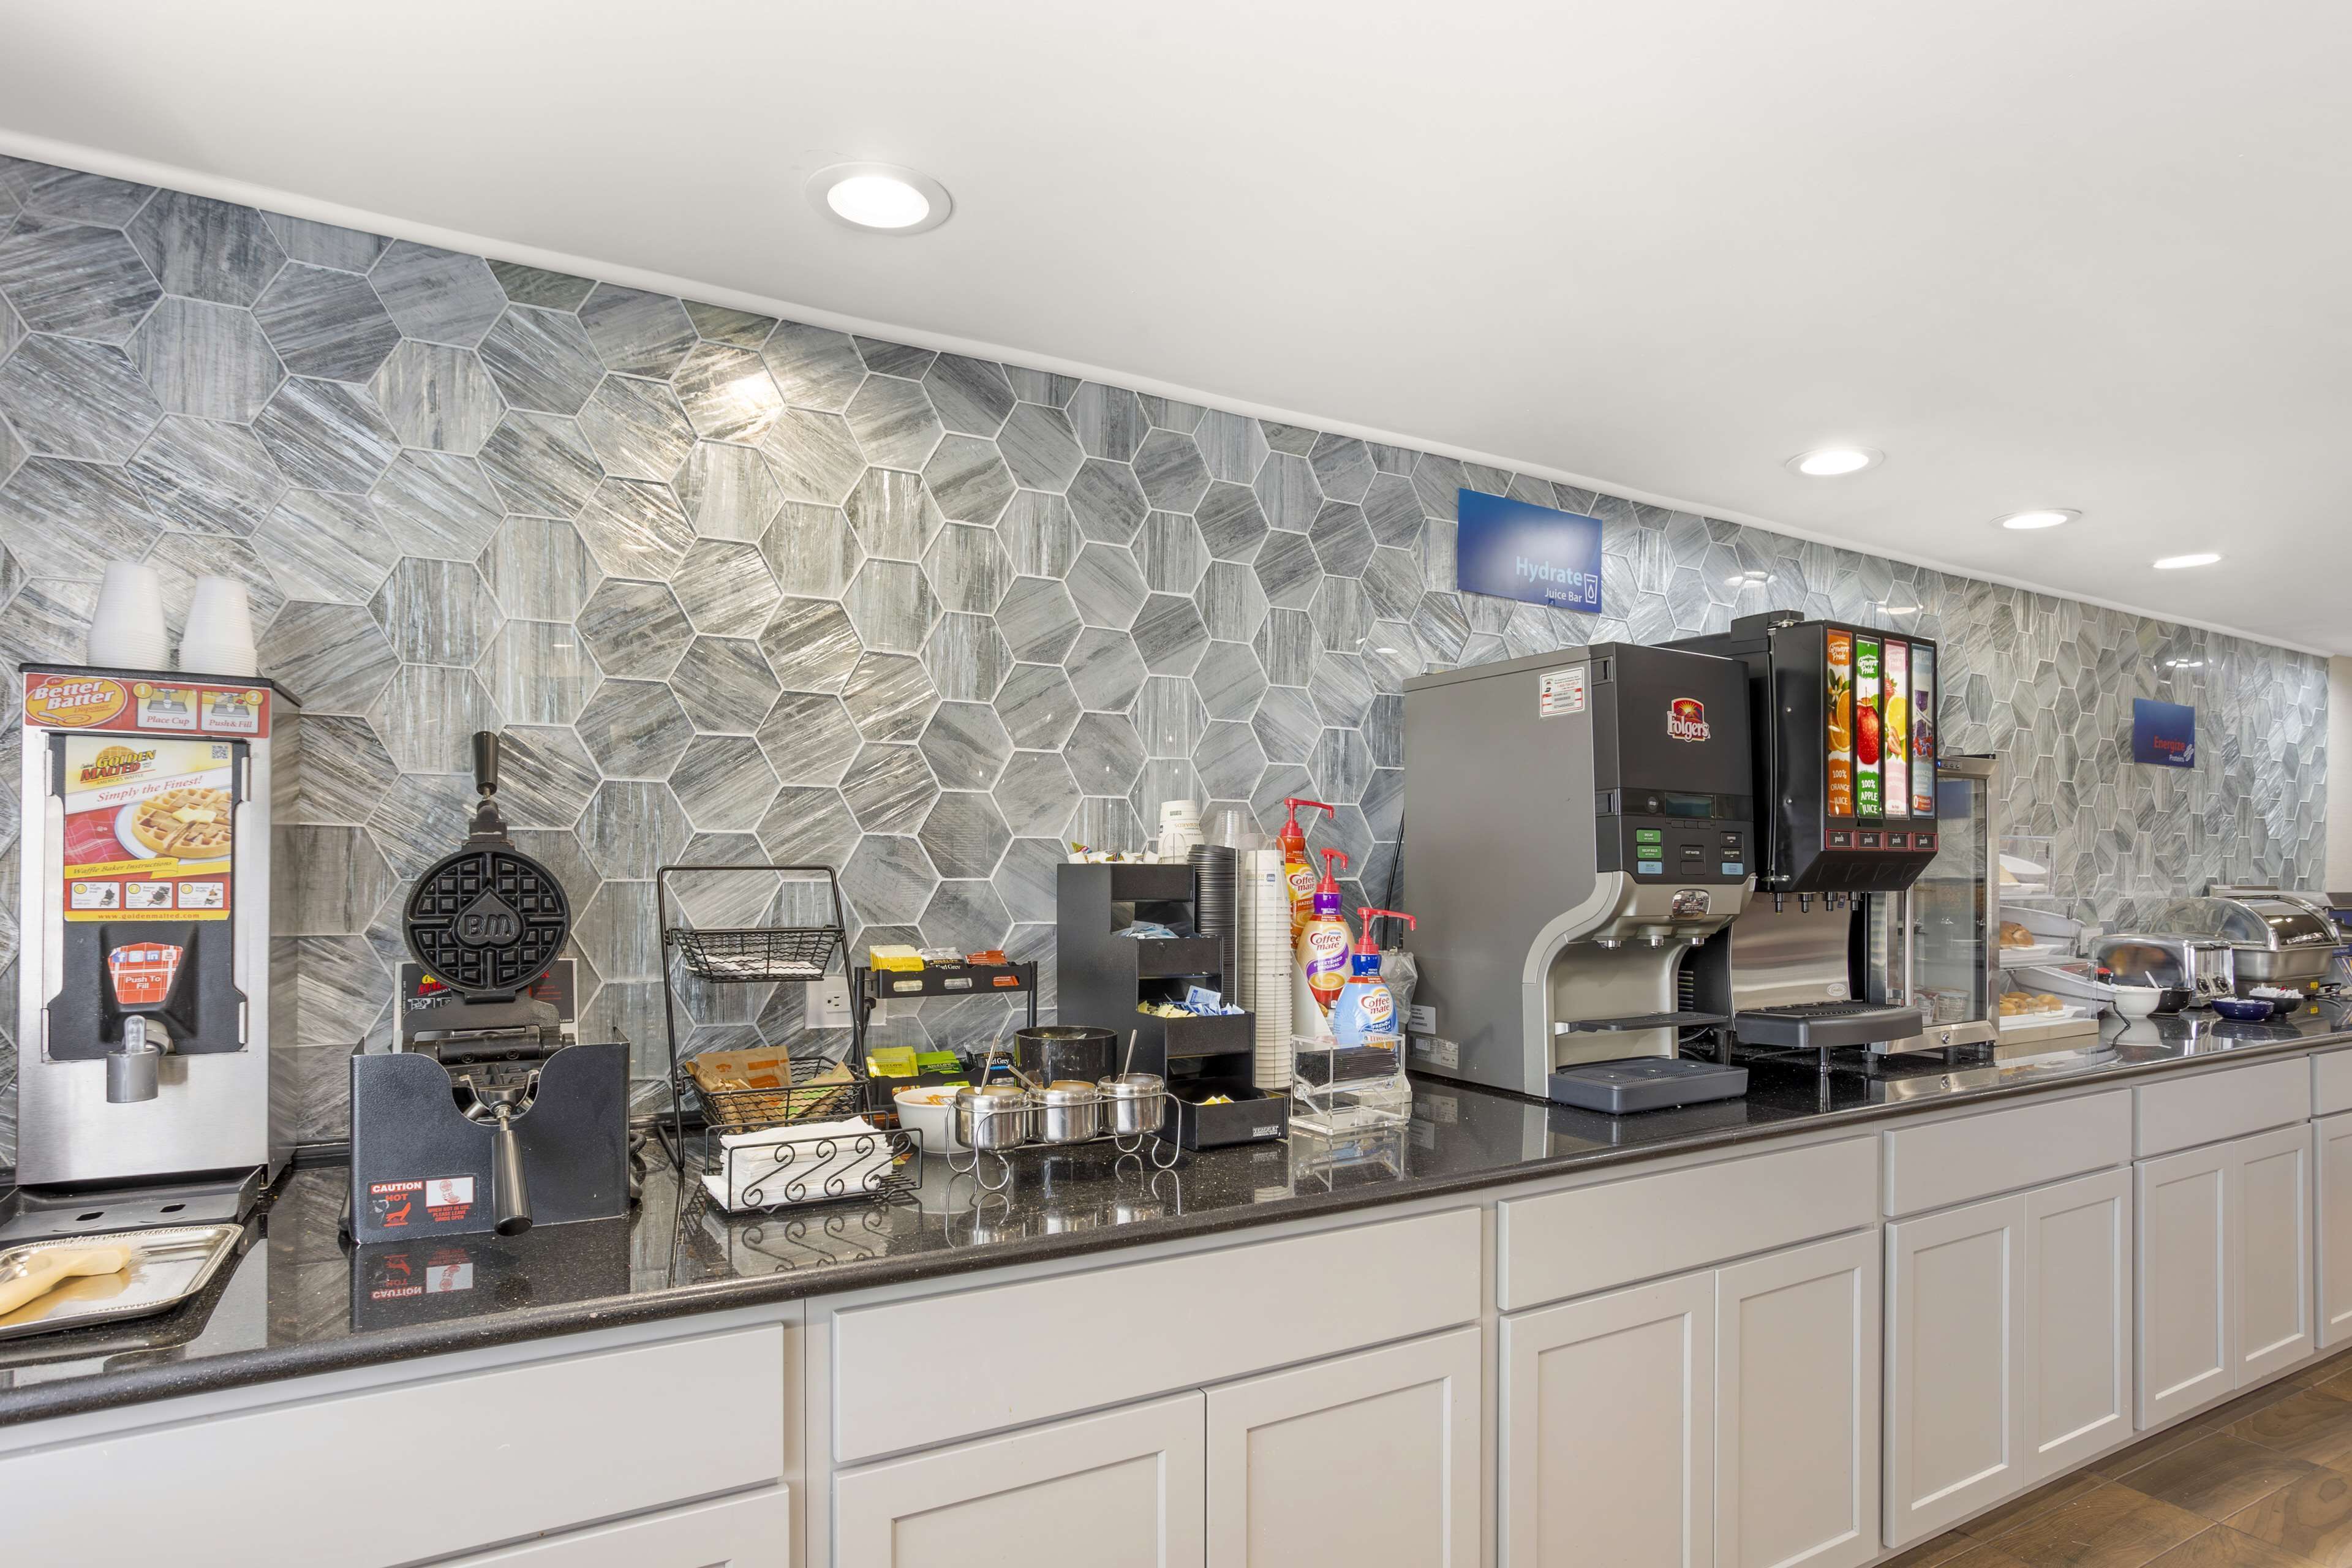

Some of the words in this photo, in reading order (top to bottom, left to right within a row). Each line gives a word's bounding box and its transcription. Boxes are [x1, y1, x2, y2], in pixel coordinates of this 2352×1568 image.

[1516, 556, 1583, 586] Hydrate
[1544, 588, 1567, 600] Juice
[1569, 591, 1583, 603] Bar
[34, 681, 103, 700] Better
[140, 686, 145, 695] 1
[47, 691, 115, 710] Batter
[172, 717, 190, 726] Cup
[1667, 711, 1709, 740] Folgers
[2154, 735, 2185, 754] Energize
[96, 750, 157, 768] GOLDEN
[80, 763, 140, 782] MALTED
[1833, 769, 1847, 778] 100%
[97, 786, 139, 802] Simply
[142, 784, 159, 794] the
[164, 775, 203, 790] Finest!
[1830, 783, 1850, 792] ORANGE
[1861, 779, 1875, 789] 100%
[1834, 796, 1848, 805] JUICE
[1861, 791, 1878, 802] APPLE
[1913, 795, 1918, 808] 0
[1862, 804, 1878, 815] JUICE
[126, 861, 172, 870] Instructions
[1289, 874, 1314, 886] Coffee
[1310, 933, 1341, 946] Coffee
[1316, 942, 1340, 951] mate
[1313, 956, 1343, 967] SWEETENED
[1361, 996, 1390, 1009] Coffee
[1370, 1005, 1390, 1014] mate
[1372, 1019, 1392, 1029] FRENCH
[1372, 1025, 1392, 1033] VANILLA
[372, 1182, 423, 1193] CAUTION
